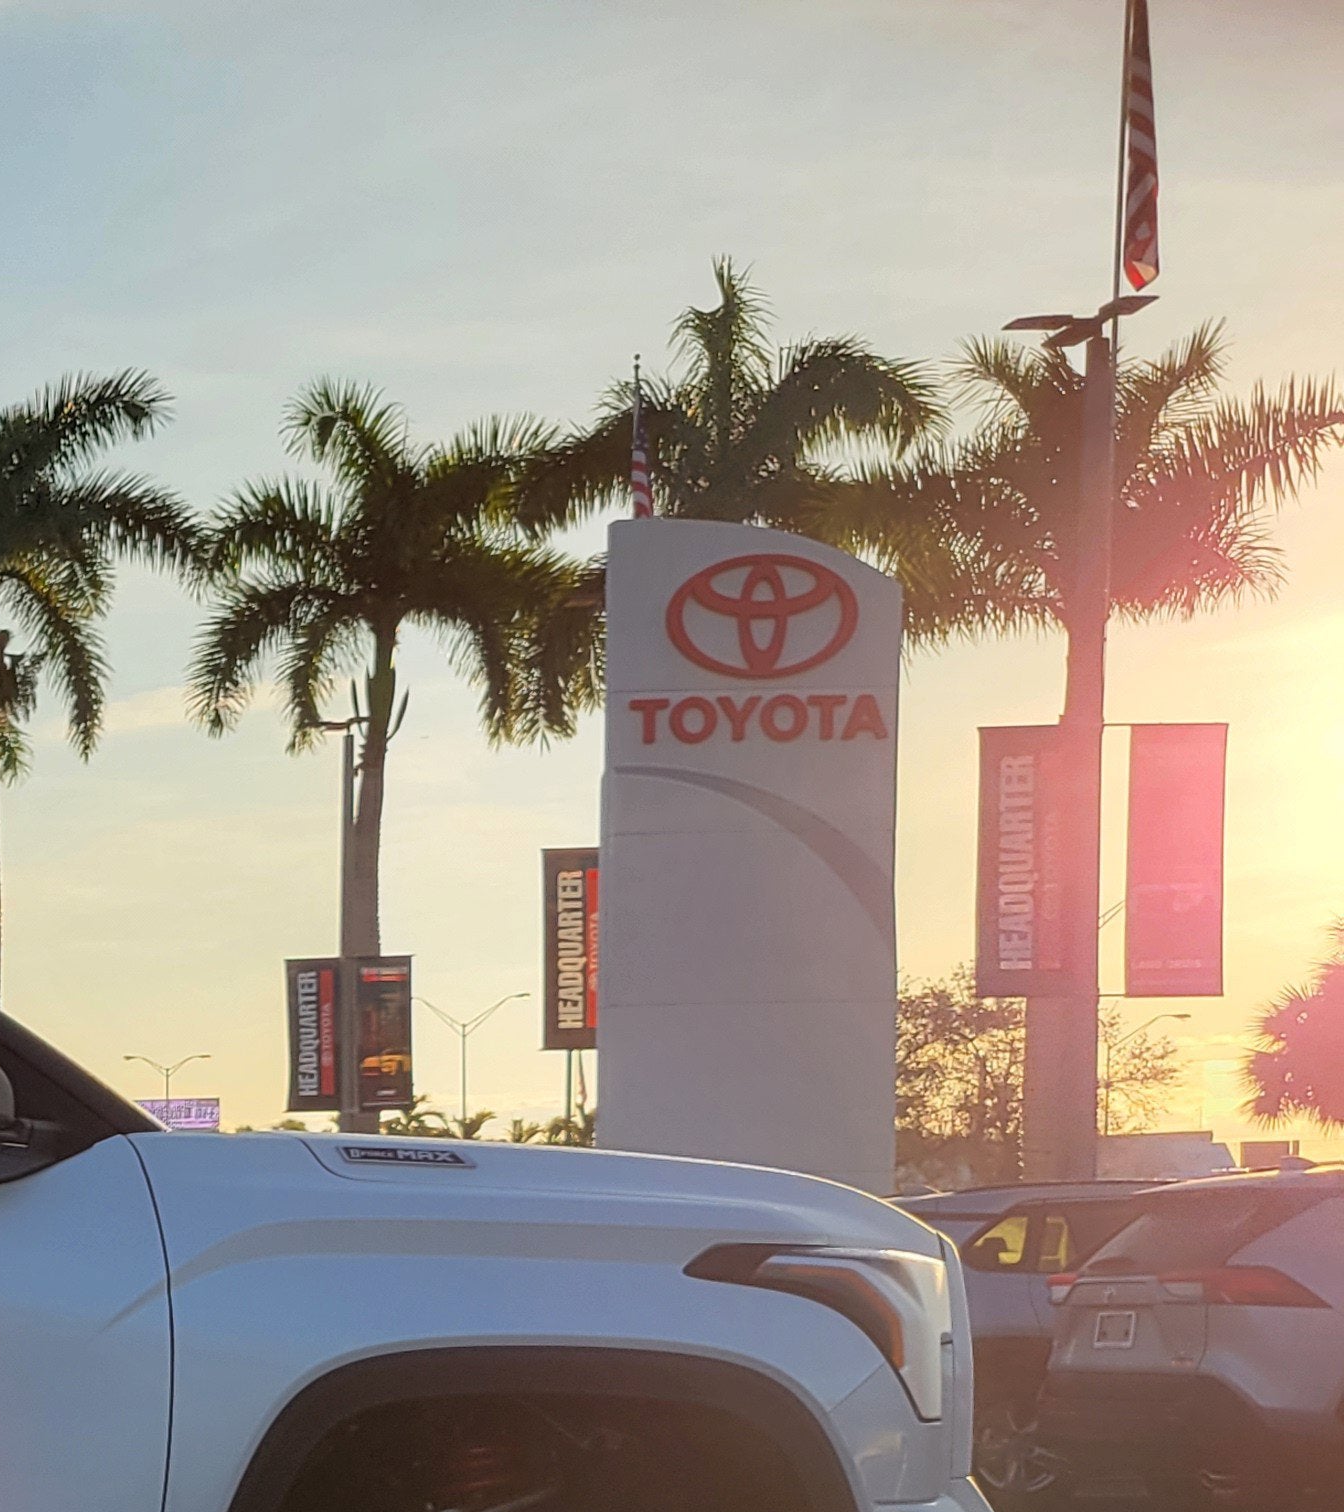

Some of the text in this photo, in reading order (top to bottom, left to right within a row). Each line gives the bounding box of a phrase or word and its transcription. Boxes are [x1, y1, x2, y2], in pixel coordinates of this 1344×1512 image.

[628, 694, 888, 745] TOYOTA
[998, 755, 1039, 970] HEADQUARTER
[557, 869, 587, 1029] HEADQUARTER
[298, 970, 320, 1097] HEADQUARTER
[321, 1003, 331, 1050] TOYOTA
[397, 1149, 455, 1162] MAX
